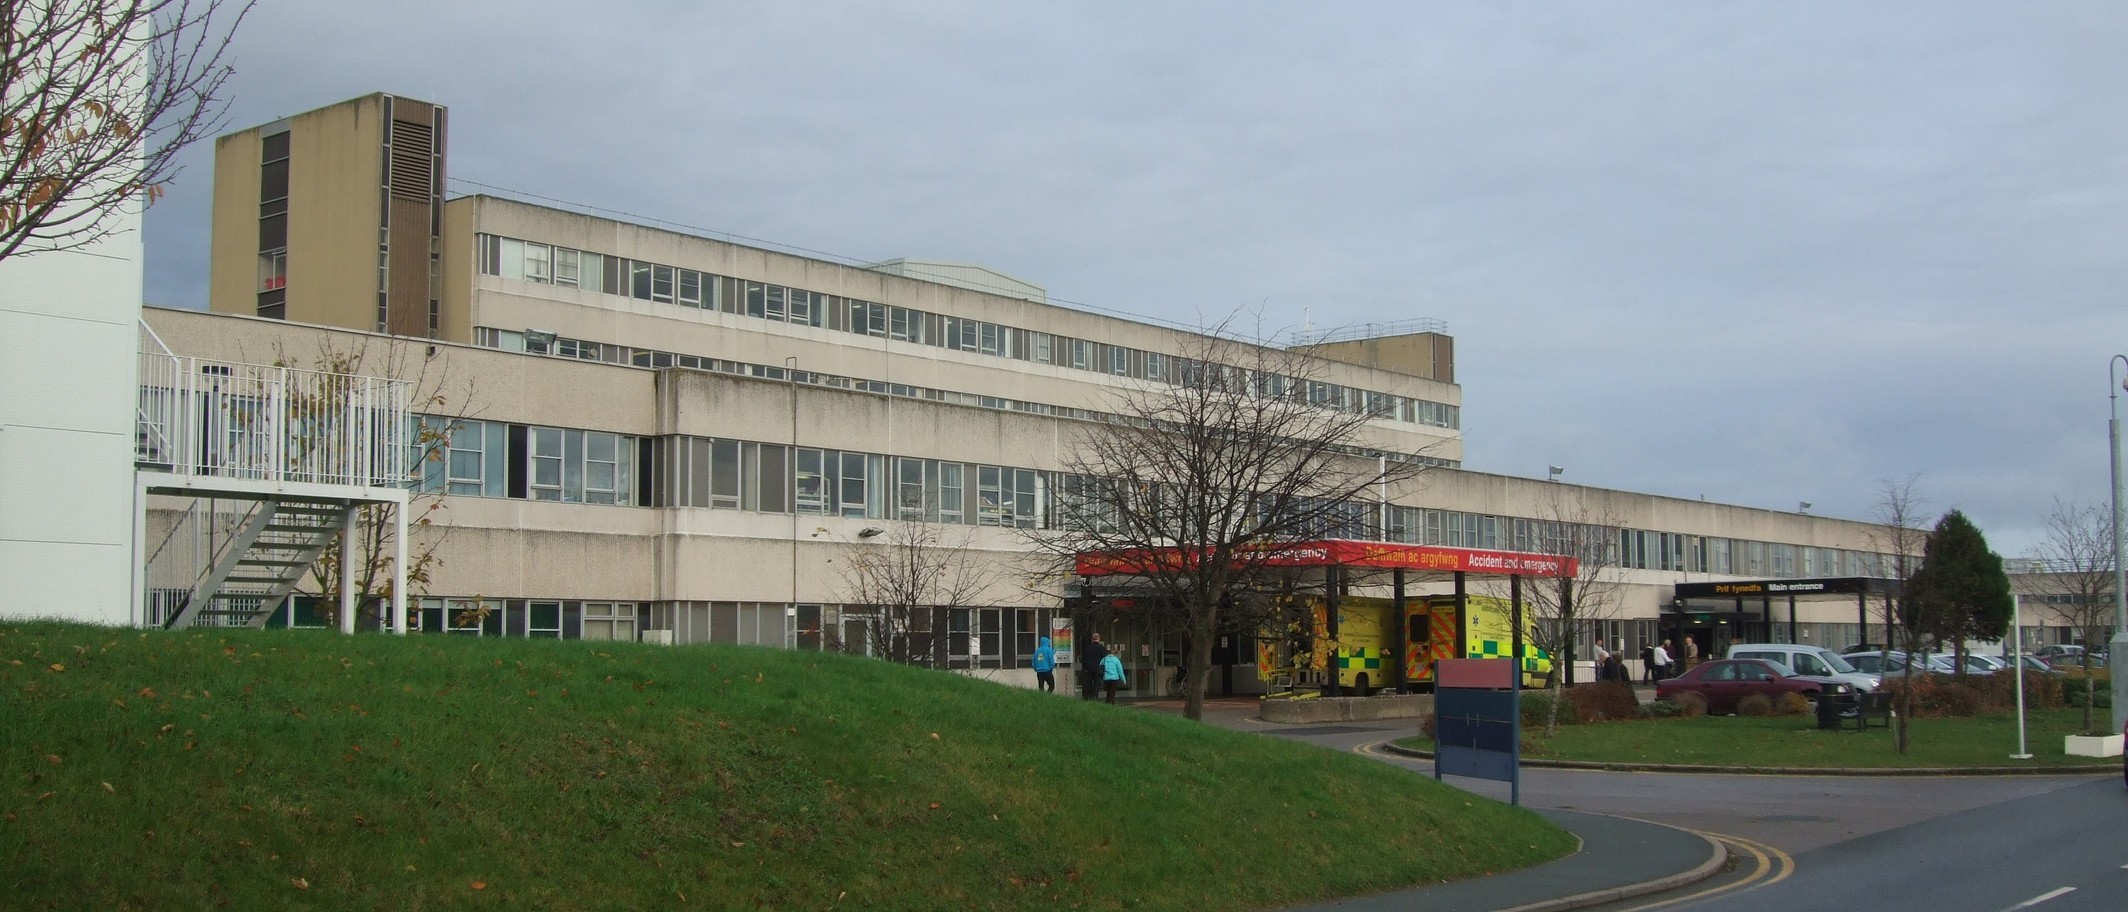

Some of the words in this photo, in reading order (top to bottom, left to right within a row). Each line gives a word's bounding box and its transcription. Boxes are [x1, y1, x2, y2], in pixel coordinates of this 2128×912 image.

[1409, 552, 1418, 563] ac
[1421, 552, 1459, 569] argyfwng
[1469, 553, 1503, 568] Accident
[1504, 556, 1518, 569] and
[1520, 559, 1558, 575] emergency
[1716, 585, 1729, 593] Prif
[1733, 584, 1761, 594] fynedfa
[1789, 583, 1824, 591] entrance
